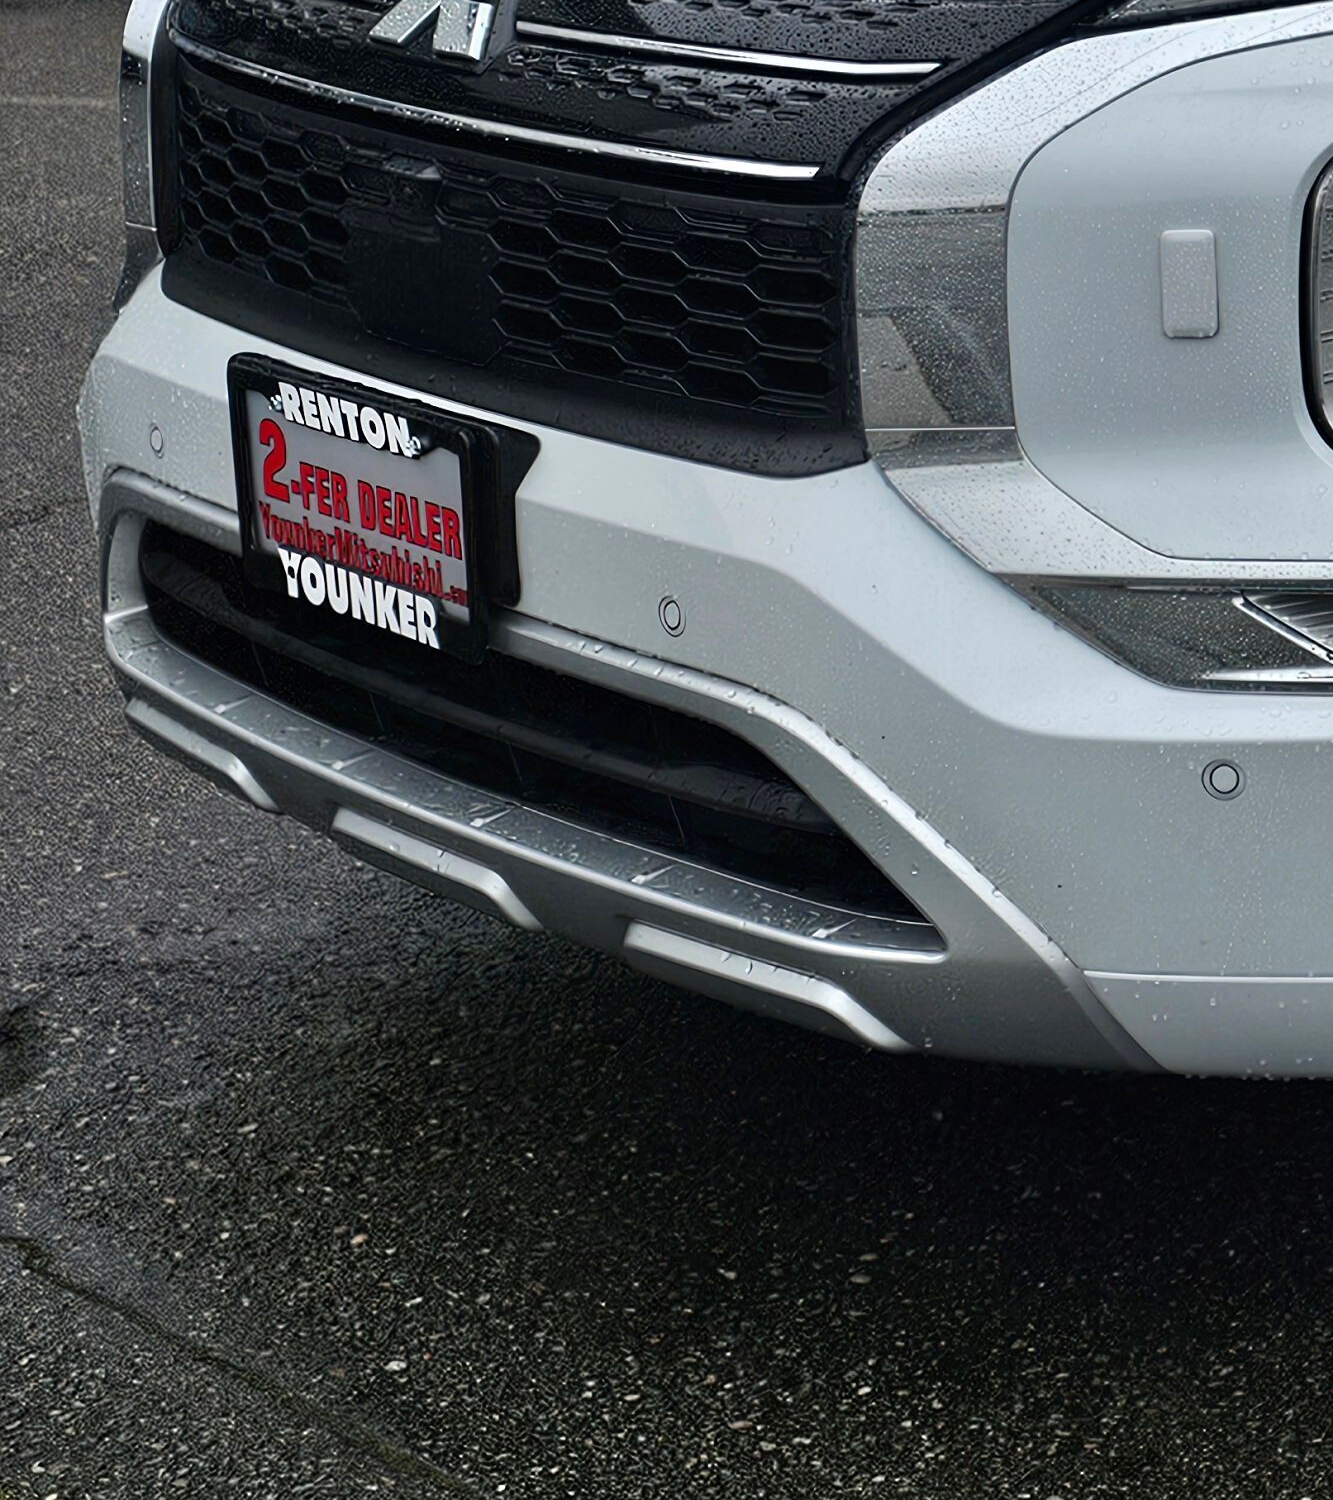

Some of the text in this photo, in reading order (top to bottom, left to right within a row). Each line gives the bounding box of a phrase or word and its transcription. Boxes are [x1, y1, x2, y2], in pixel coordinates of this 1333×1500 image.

[278, 382, 413, 458] RENTON
[259, 418, 463, 561] 2-FER DEALER
[278, 548, 440, 650] YOUNKER
